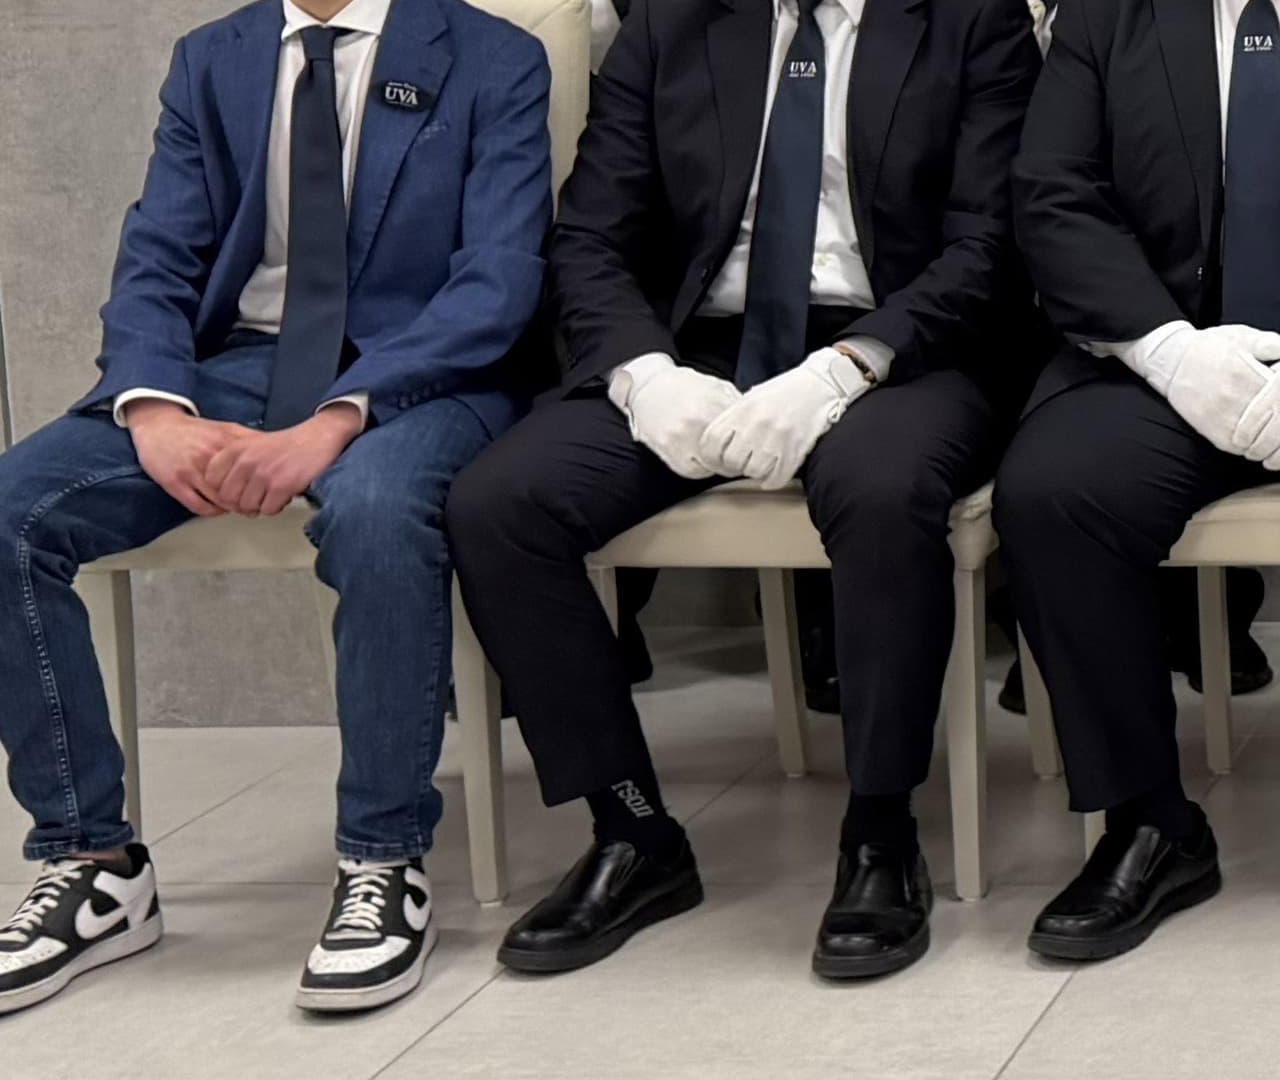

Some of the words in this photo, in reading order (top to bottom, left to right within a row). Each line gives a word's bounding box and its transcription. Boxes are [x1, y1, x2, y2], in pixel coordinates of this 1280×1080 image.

[1244, 35, 1273, 47] UVA
[790, 61, 817, 73] UVA
[384, 86, 418, 105] UVA
